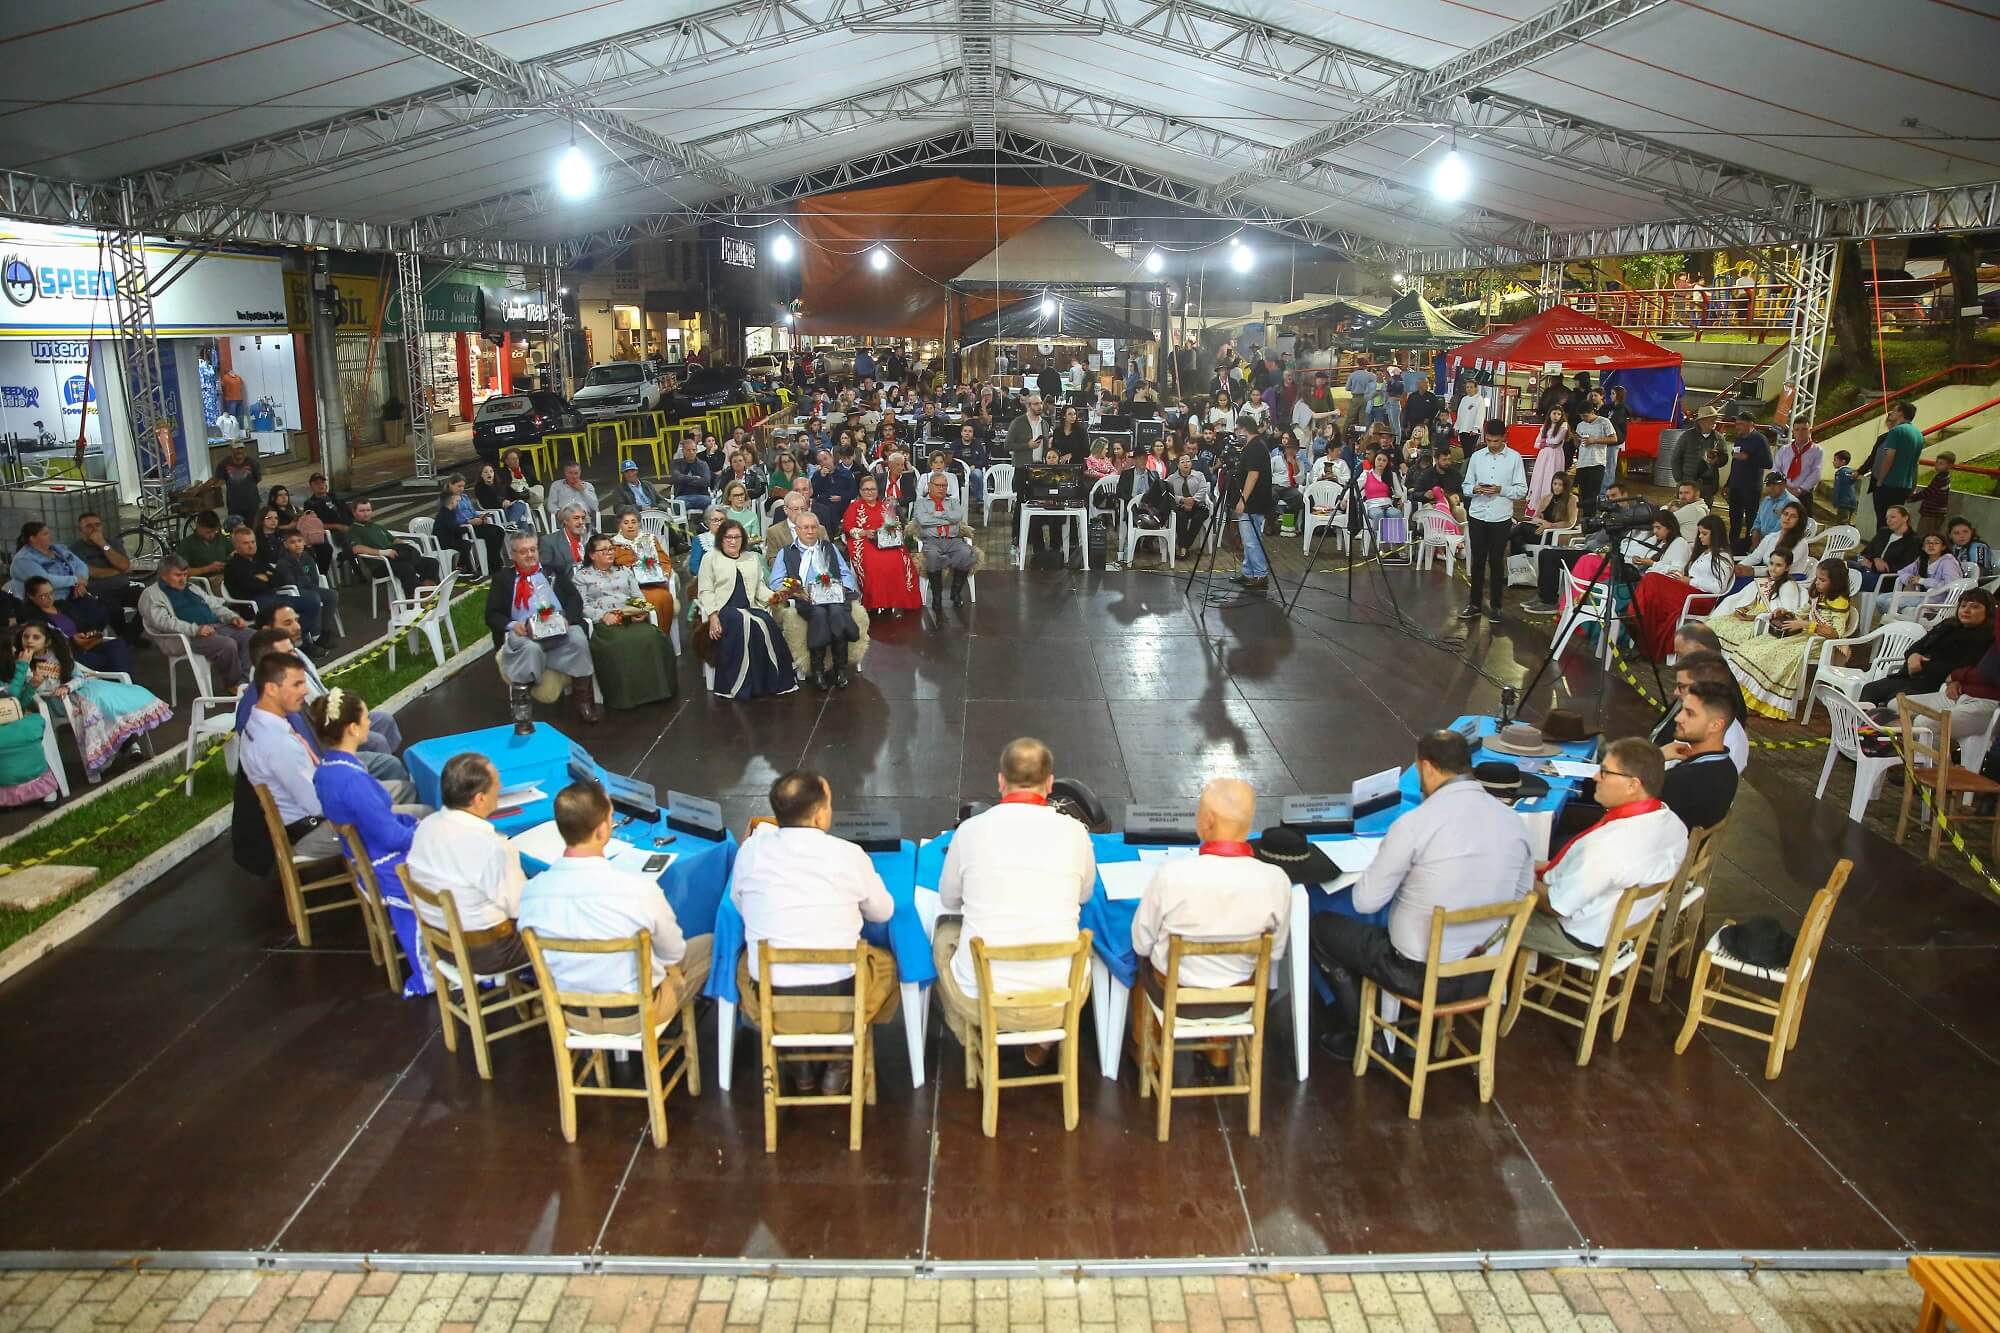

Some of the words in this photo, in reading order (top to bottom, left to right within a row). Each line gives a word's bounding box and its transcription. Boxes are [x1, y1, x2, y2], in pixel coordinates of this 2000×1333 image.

[39, 266, 116, 297] SPEED
[293, 296, 368, 327] BSIL
[1554, 333, 1615, 345] BRAHMA
